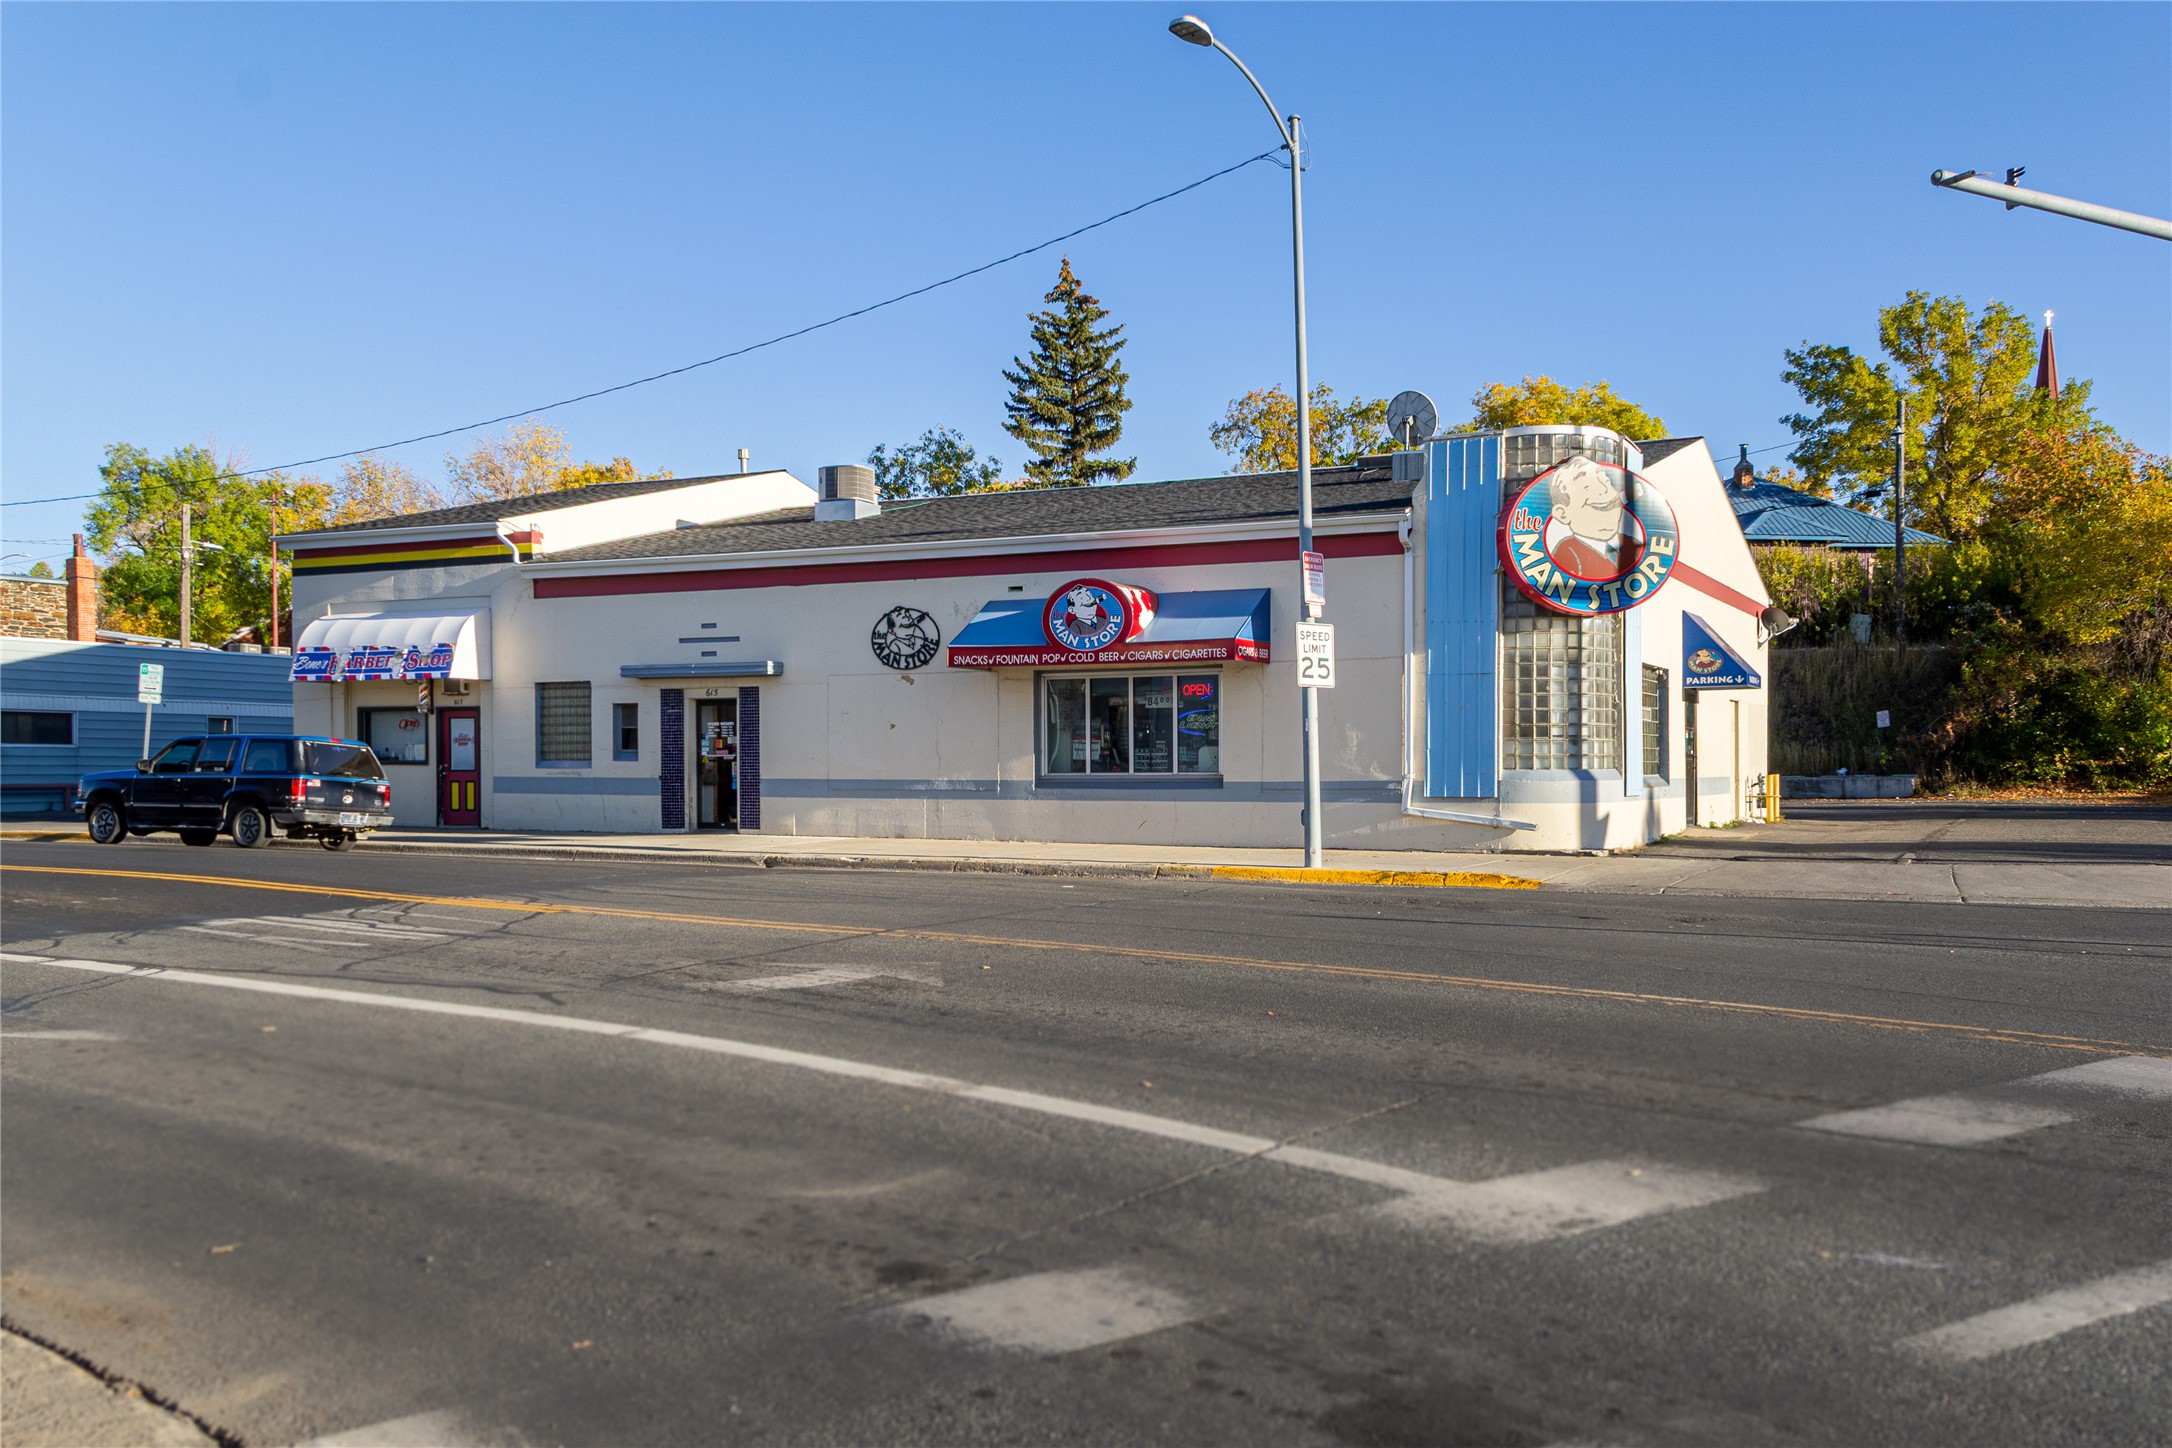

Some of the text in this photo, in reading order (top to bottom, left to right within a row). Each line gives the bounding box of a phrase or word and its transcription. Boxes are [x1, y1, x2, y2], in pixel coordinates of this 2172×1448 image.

[1514, 507, 1542, 531] the
[1512, 533, 1674, 610] MAN STORE
[873, 630, 886, 639] the
[1053, 615, 1120, 648] MAN STORE
[1300, 630, 1330, 641] SPEED
[873, 637, 938, 669] MAN STORE
[1237, 645, 1255, 657] CIGARS
[1259, 648, 1269, 659] BEER
[1303, 644, 1327, 653] LIMIT
[954, 648, 1227, 665] SNACKS FOUNTAIN POP COLD BEER CIGARS CIGARETTES
[1301, 656, 1330, 679] 25
[1689, 661, 1703, 673] MAN
[1686, 675, 1733, 685] PARKING
[706, 688, 718, 697] 615
[1182, 683, 1210, 696] OPEN
